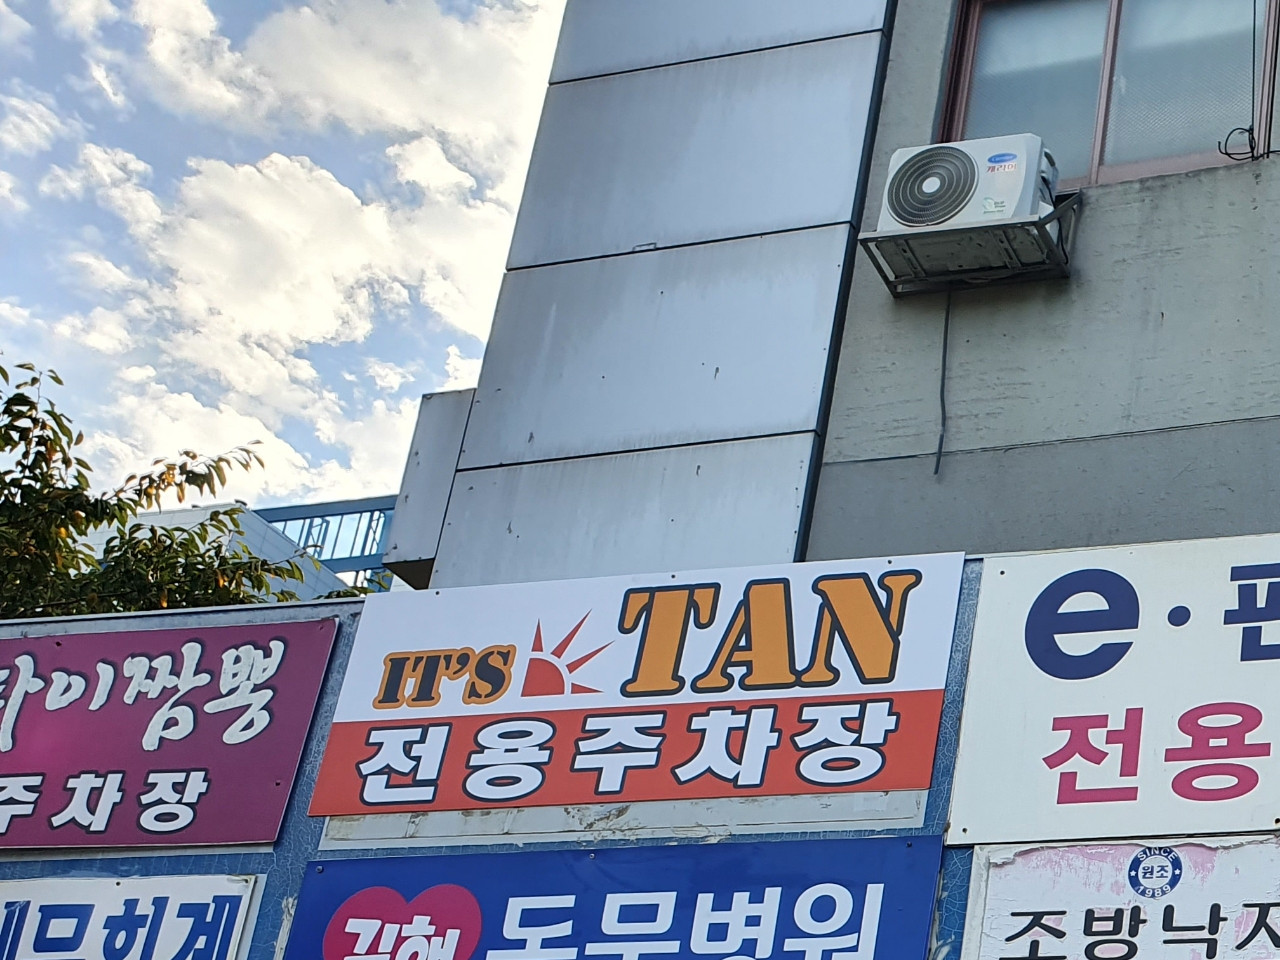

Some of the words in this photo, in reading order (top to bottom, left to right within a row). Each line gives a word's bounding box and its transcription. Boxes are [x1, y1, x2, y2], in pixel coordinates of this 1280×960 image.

[618, 569, 922, 699] TAN
[358, 699, 902, 806] 전용주차장
[1137, 847, 1178, 862] SINCE
[1142, 865, 1169, 880] 원조
[1135, 884, 1171, 898] 1989
